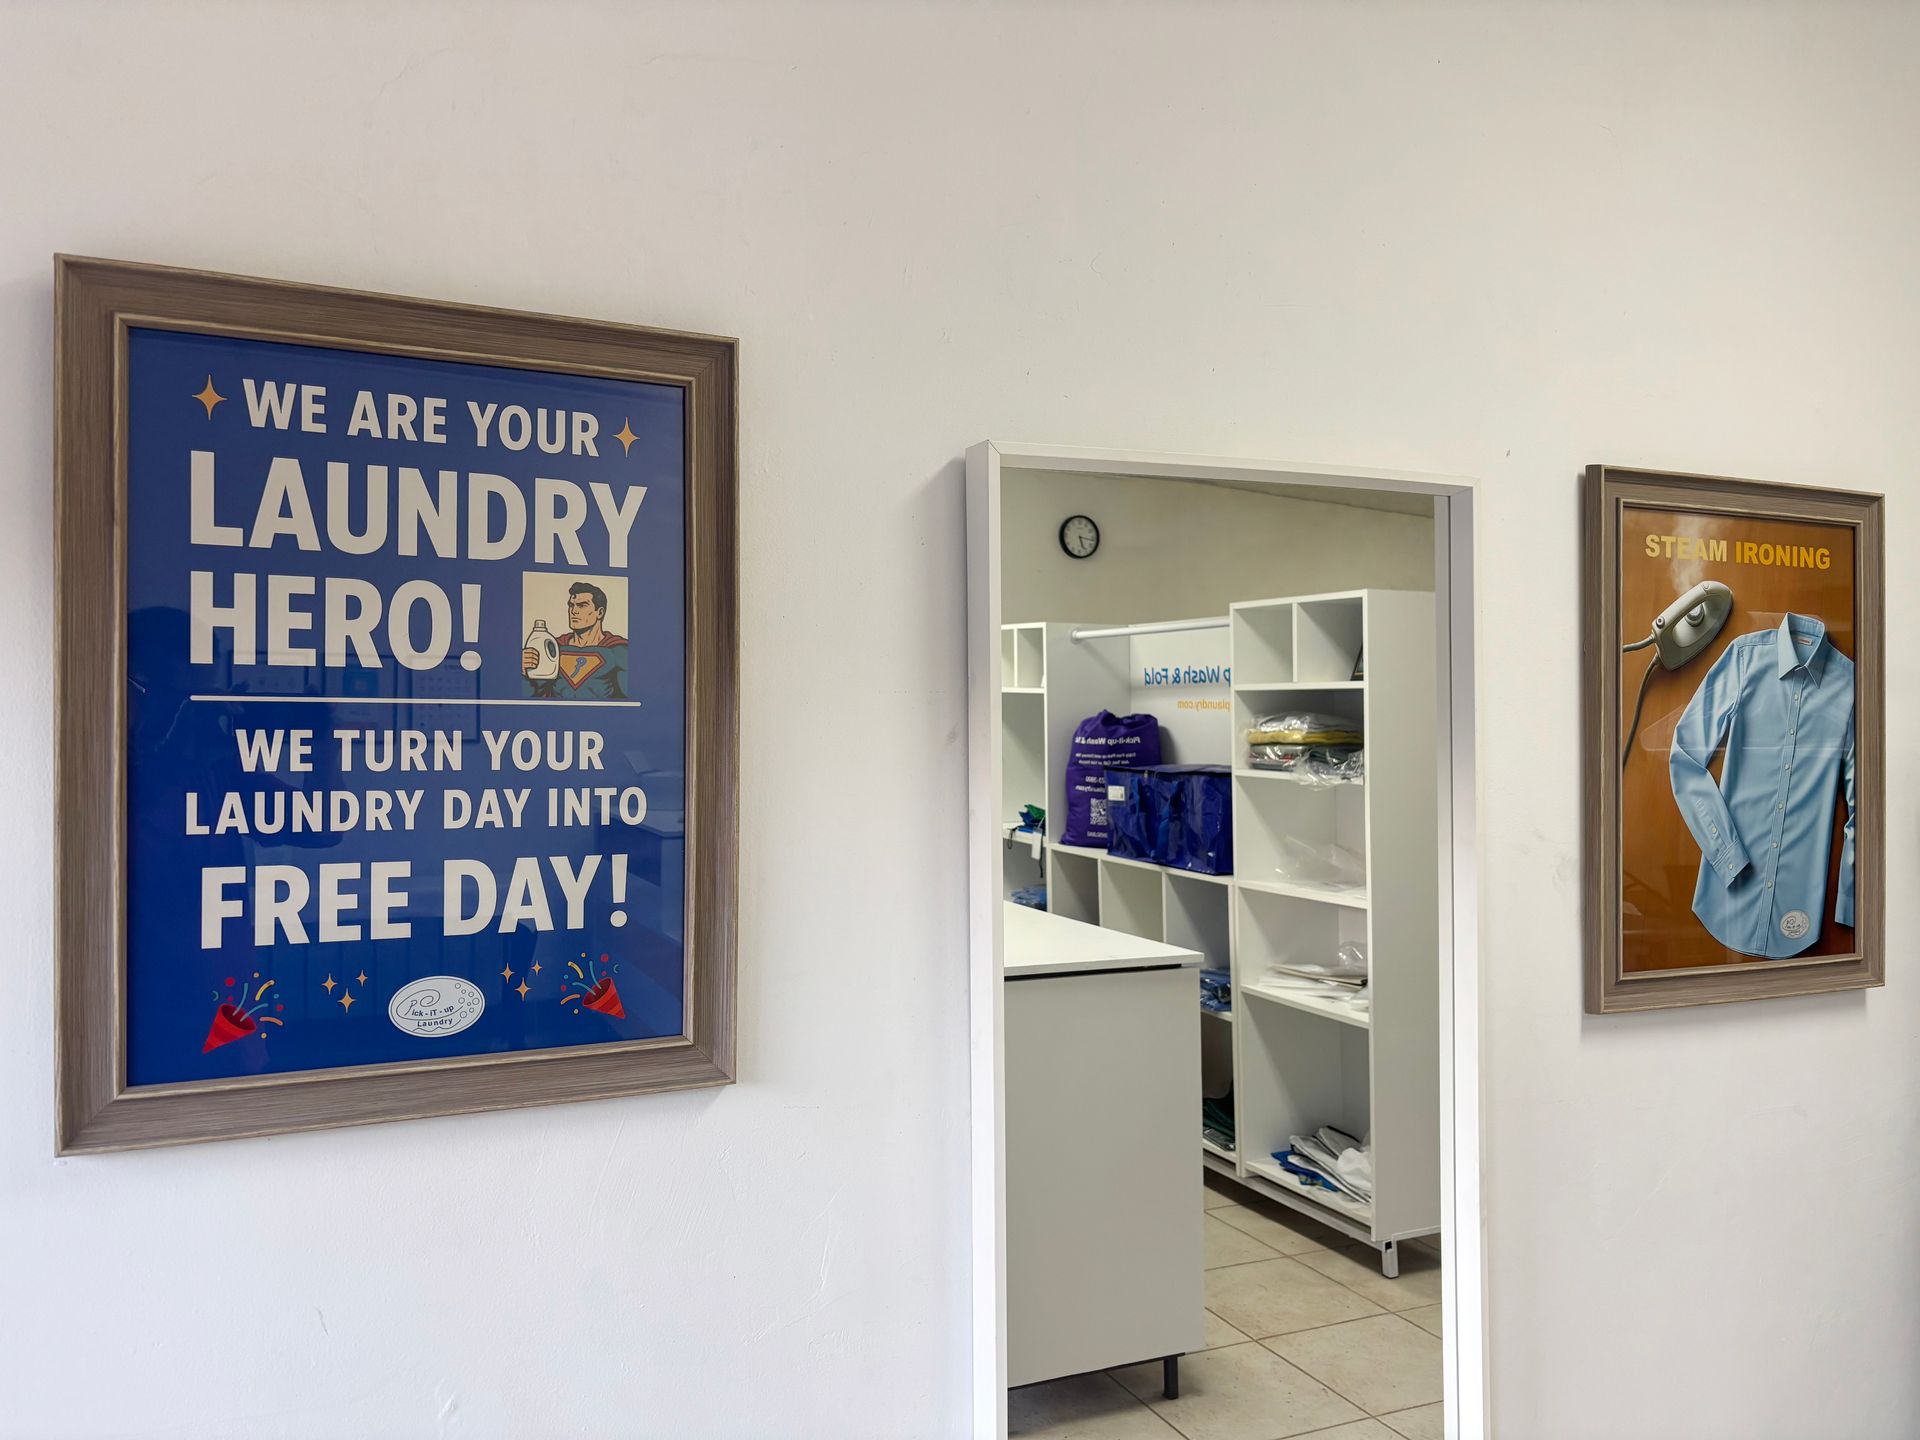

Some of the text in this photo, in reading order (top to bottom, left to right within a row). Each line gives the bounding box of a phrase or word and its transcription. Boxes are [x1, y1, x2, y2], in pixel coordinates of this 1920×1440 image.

[243, 378, 600, 457] WE ARE YOUR
[190, 450, 648, 569] LAUNDRY
[1645, 534, 1831, 570] STEAM IRONING
[190, 570, 482, 672] HERO!
[236, 729, 605, 772] WE TURN YOUR
[186, 786, 647, 835] LAUNDRY DAY INTO
[202, 853, 629, 949] FREE DAY!
[417, 1018, 453, 1027] Laundry
